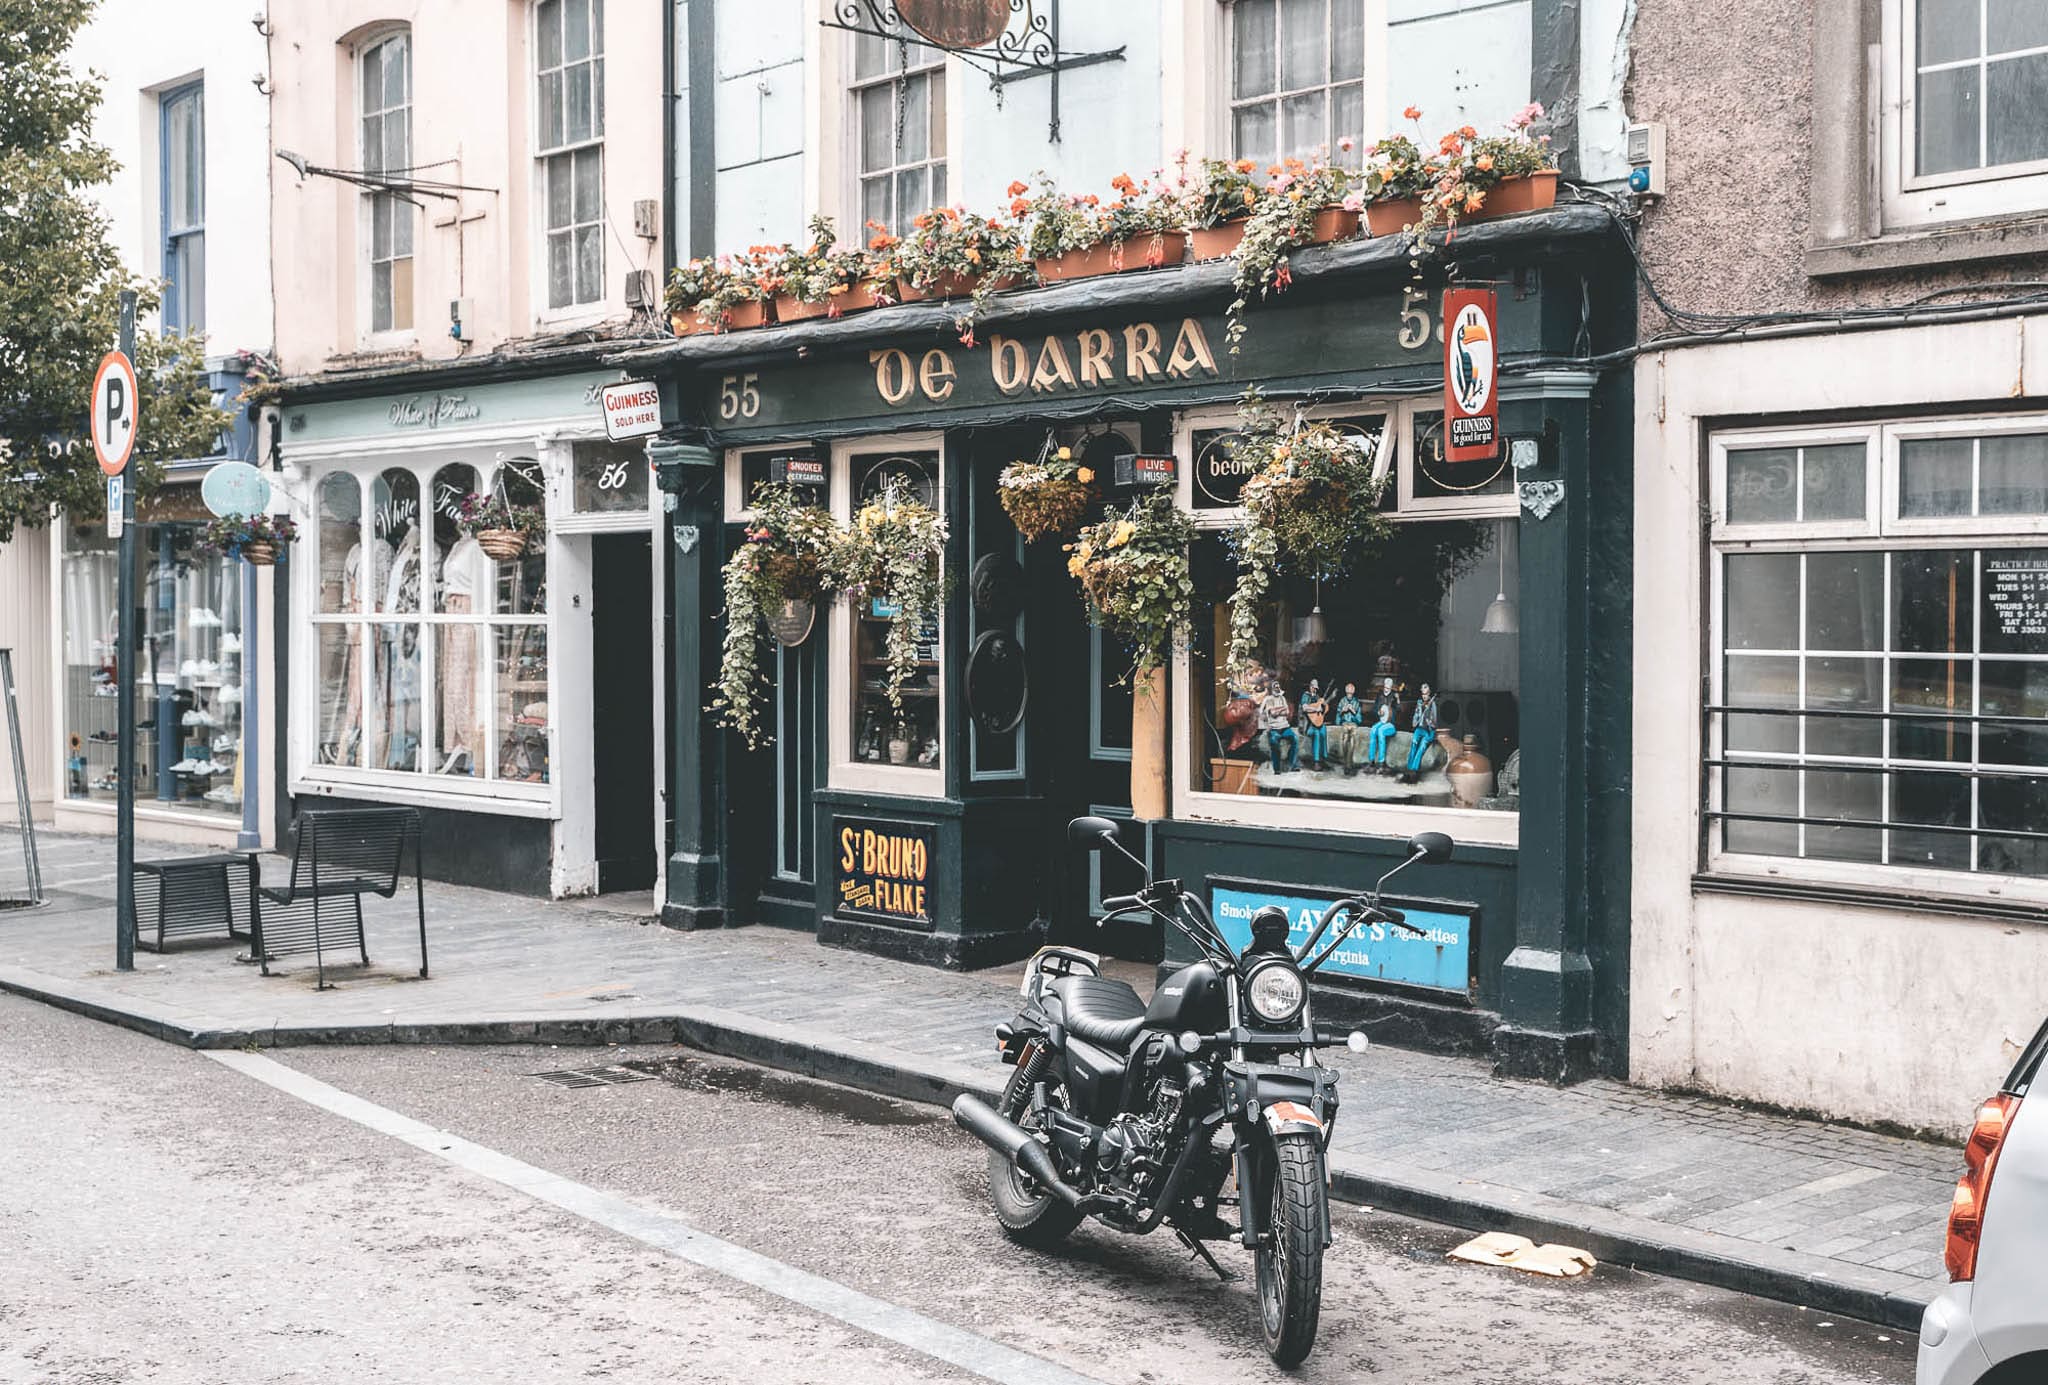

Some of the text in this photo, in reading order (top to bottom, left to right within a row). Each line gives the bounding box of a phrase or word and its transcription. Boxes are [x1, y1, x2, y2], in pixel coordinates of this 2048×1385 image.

[1399, 287, 1446, 349] 5
[606, 389, 658, 411] GUINNESS
[720, 373, 761, 420] 55
[440, 395, 480, 420] Fawn
[615, 412, 656, 428] SOLD HERE
[1453, 416, 1491, 433] GUINNESS
[1460, 432, 1473, 447] good
[1481, 432, 1492, 444] you
[791, 461, 823, 472] SNOOKER
[1145, 459, 1166, 470] LIVE
[599, 461, 630, 489] 56
[1143, 471, 1169, 481] MUSIC
[375, 498, 417, 538] White
[1990, 561, 2028, 569] PRACTICE
[2025, 618, 2042, 626] 10-1
[863, 829, 928, 881] BRUNO
[875, 879, 926, 915] FLAKE
[1220, 901, 1256, 920] Smok
